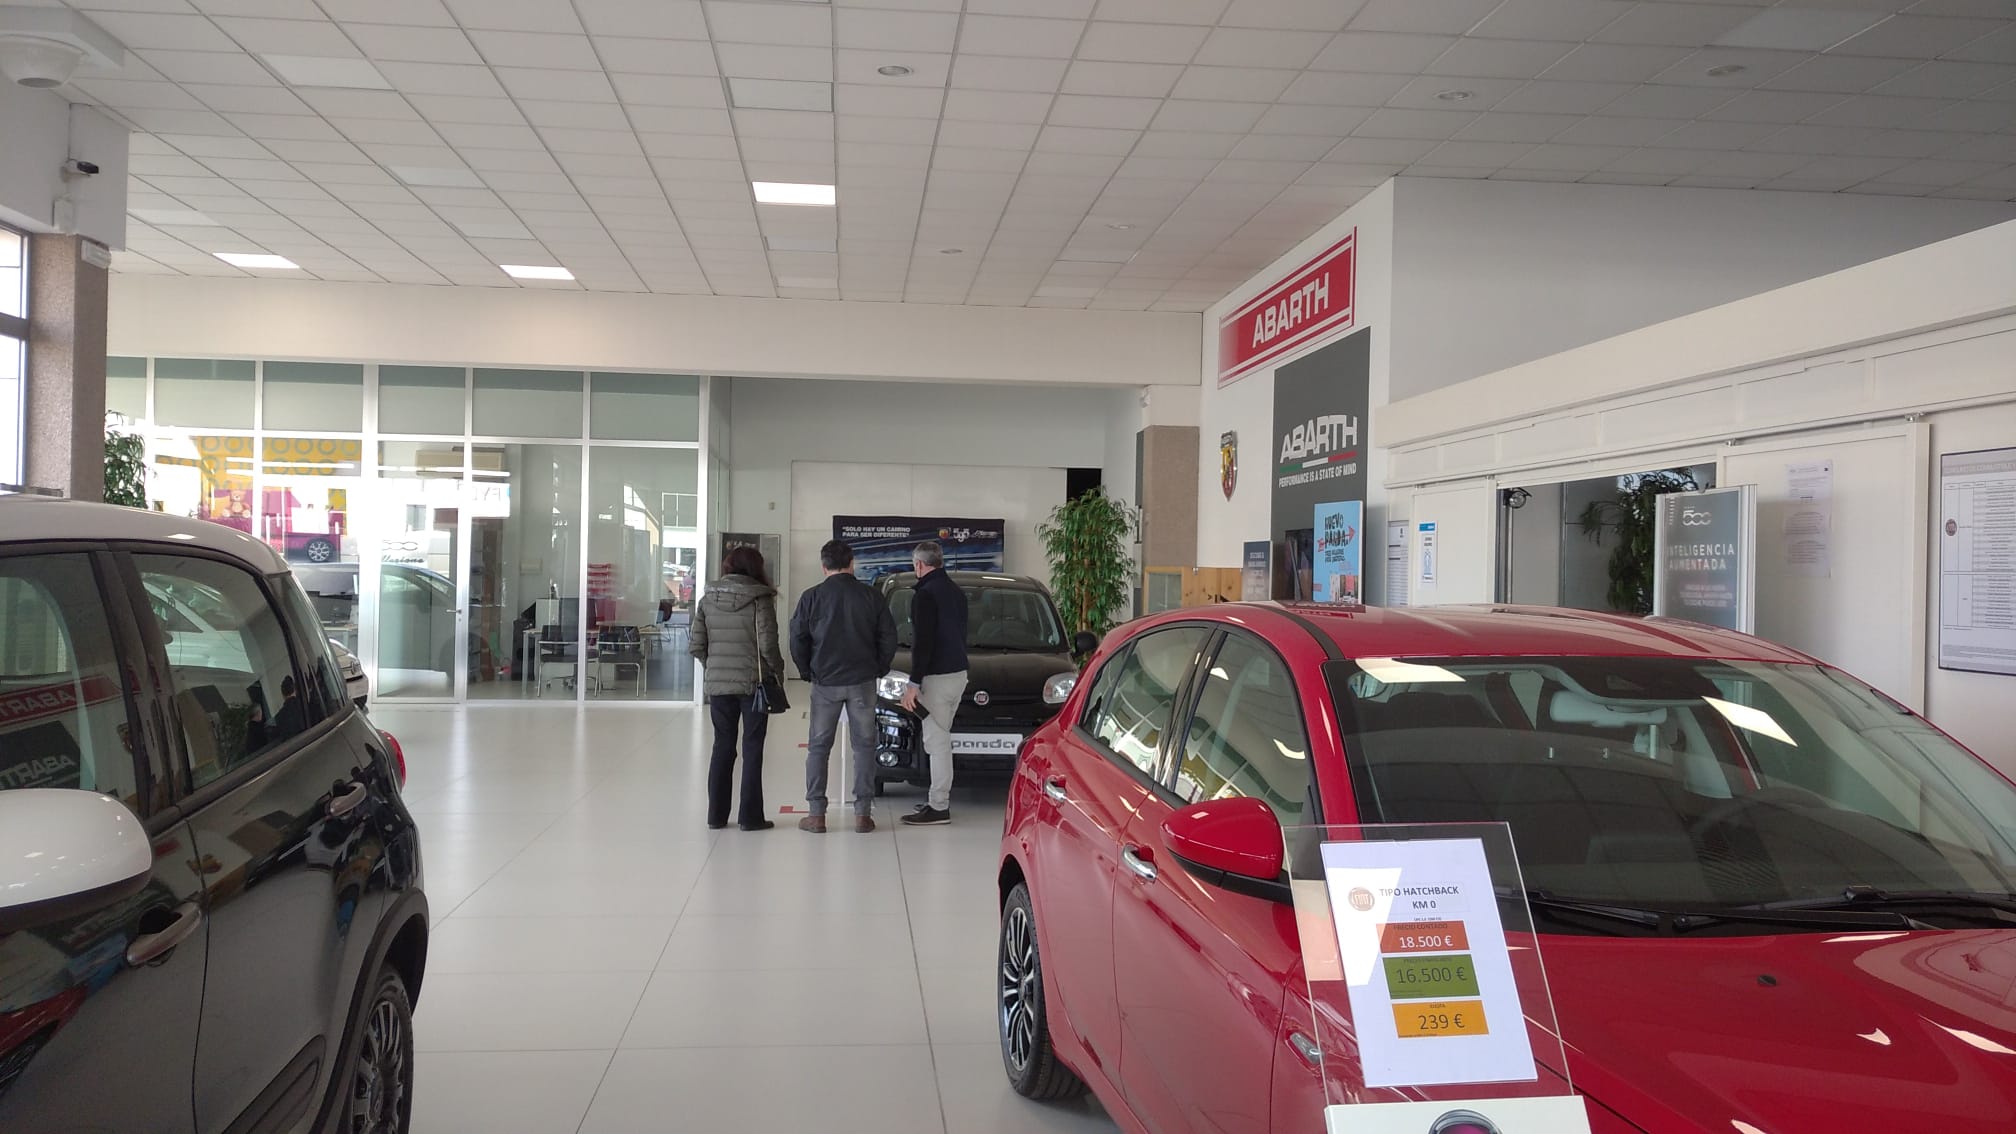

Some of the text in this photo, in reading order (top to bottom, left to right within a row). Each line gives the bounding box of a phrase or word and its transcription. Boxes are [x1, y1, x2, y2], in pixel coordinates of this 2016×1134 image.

[1252, 272, 1329, 348] ABARTH
[1280, 414, 1358, 464] ABARTH
[1279, 471, 1309, 488] PERFORMANCE
[1309, 471, 1315, 482] IS
[1319, 467, 1335, 480] STATE
[1335, 465, 1343, 477] OF
[1342, 462, 1357, 476] MIND
[1325, 512, 1344, 530] NUEVO
[1683, 510, 1711, 526] 500
[1667, 543, 1735, 556] INTELIGENCIA
[1669, 558, 1727, 570] AUMENTADA
[951, 739, 1016, 750] panda
[1379, 886, 1460, 897] TIPO HATCHBACK
[1412, 900, 1428, 909] KM
[1400, 935, 1454, 948] 18.500 €
[1396, 966, 1468, 984] 16.500 €
[1418, 1013, 1465, 1030] 239 €
